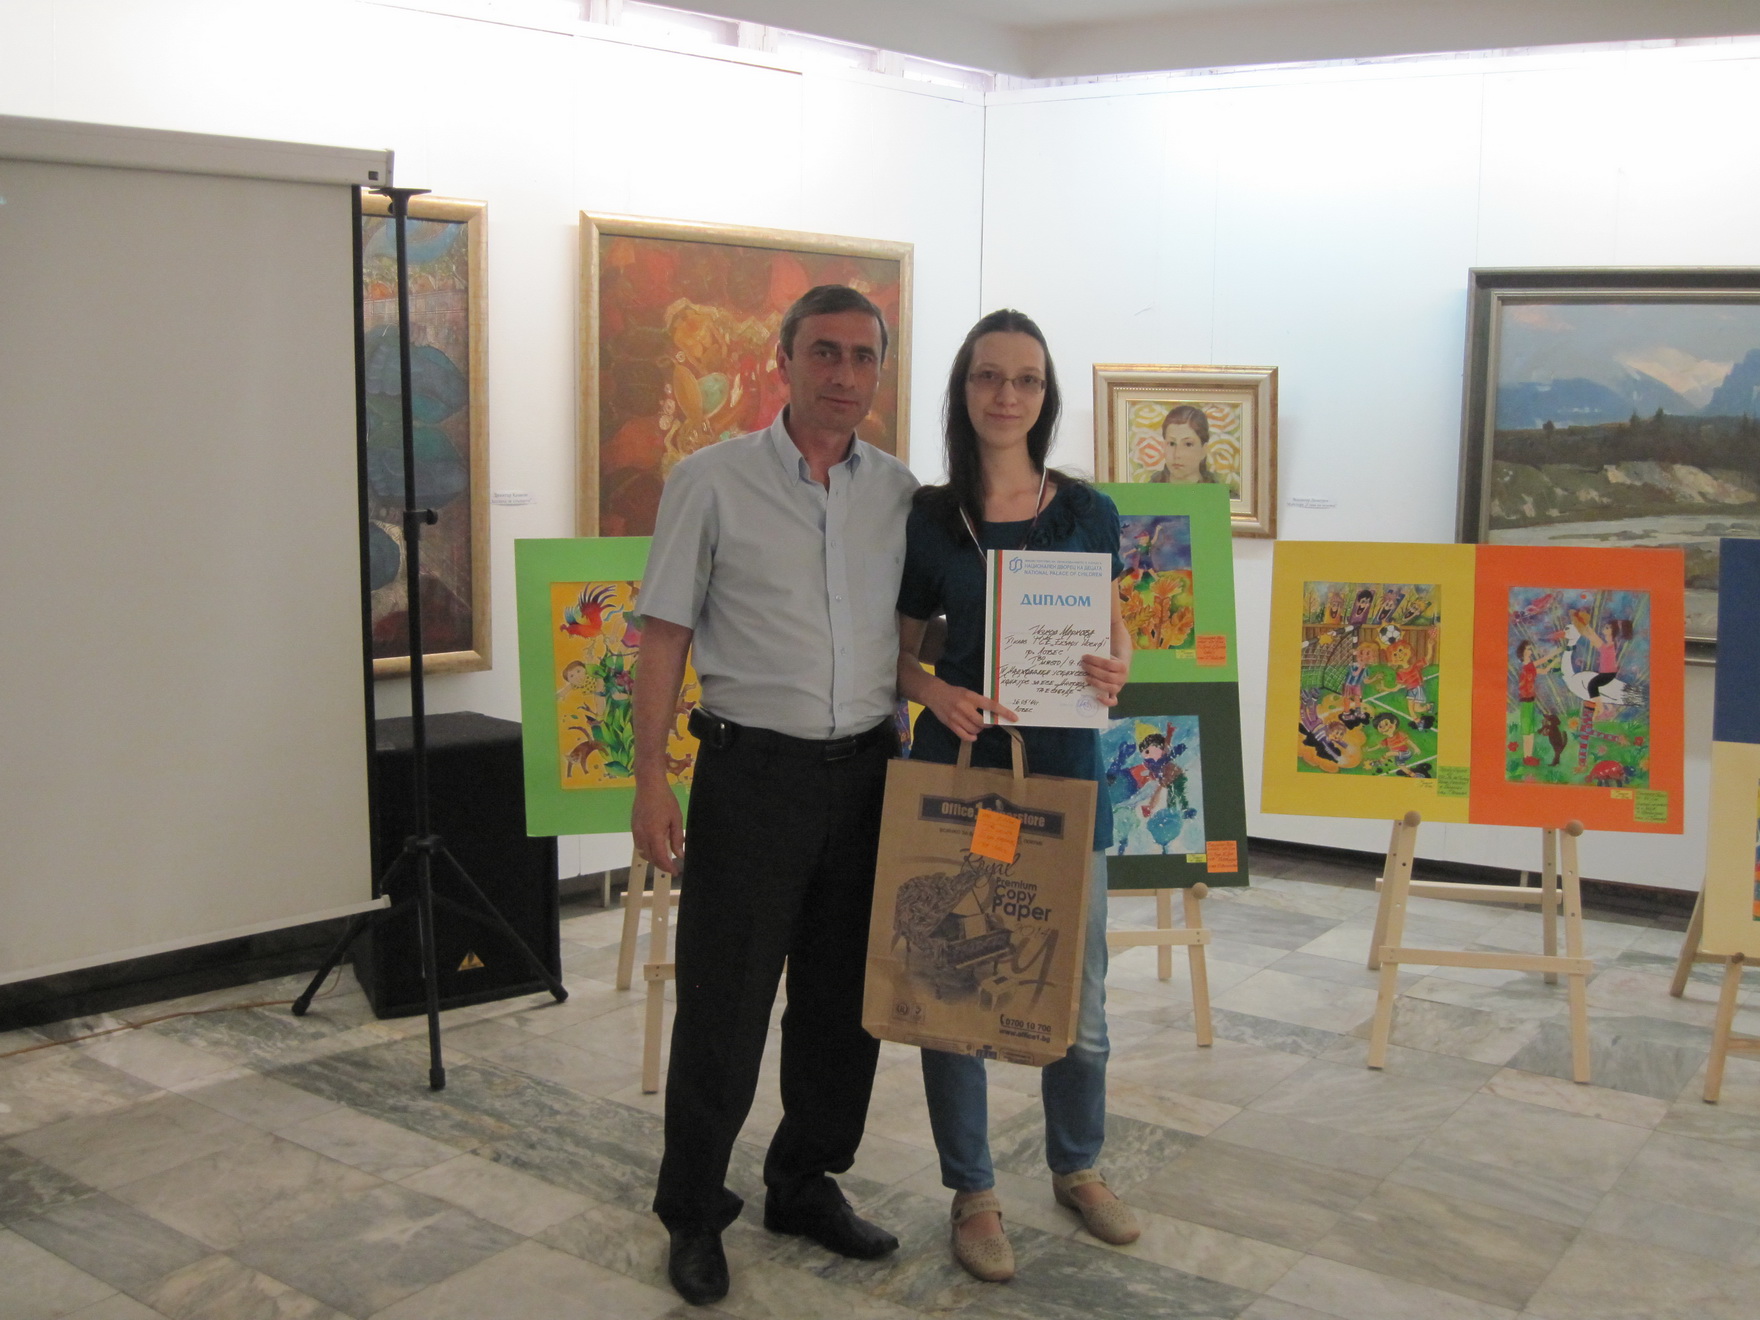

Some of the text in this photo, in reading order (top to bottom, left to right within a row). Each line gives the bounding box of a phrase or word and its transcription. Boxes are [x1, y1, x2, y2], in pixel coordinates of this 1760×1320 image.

[1020, 593, 1091, 607] ДИПЛОМ
[941, 801, 974, 818] Office
[996, 876, 1038, 891] Premium
[994, 884, 1036, 905] Copy
[992, 896, 1052, 922] Paper
[1005, 1017, 1052, 1033] 0700 10 700
[999, 1029, 1050, 1043] www.office1.bg
